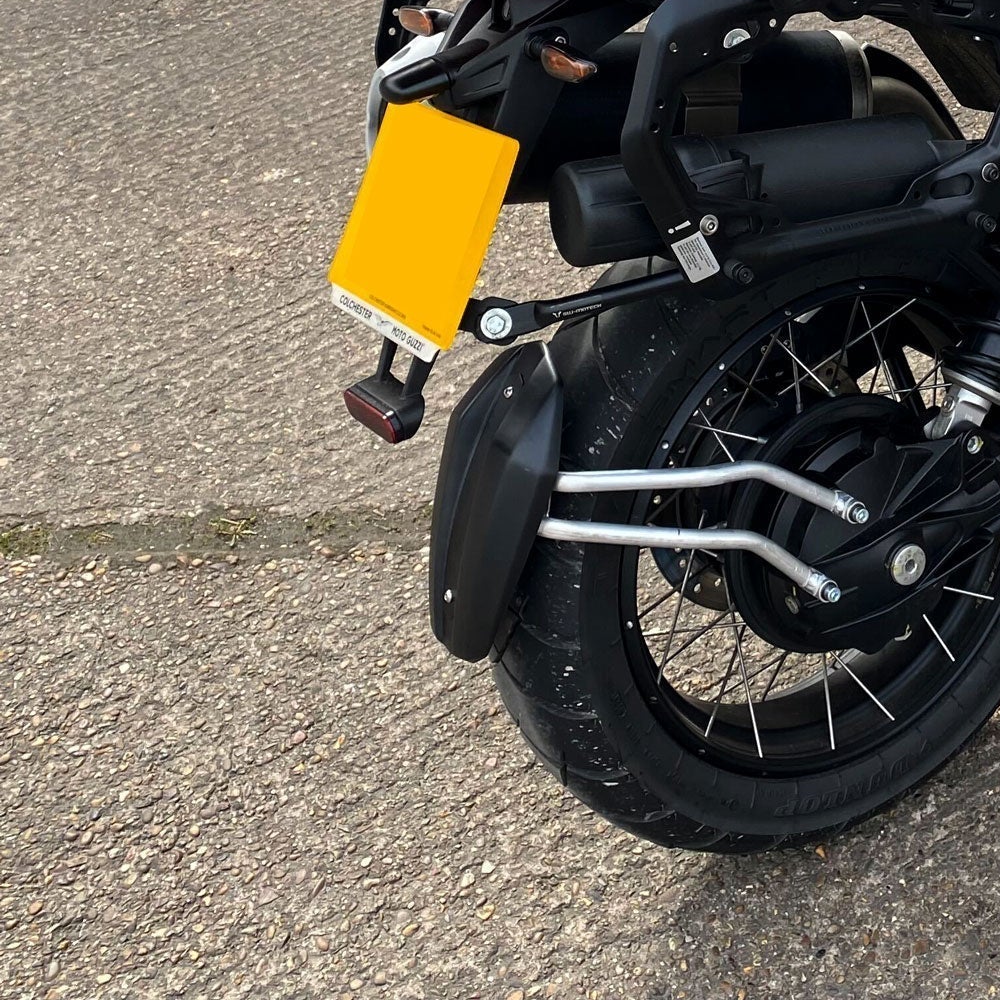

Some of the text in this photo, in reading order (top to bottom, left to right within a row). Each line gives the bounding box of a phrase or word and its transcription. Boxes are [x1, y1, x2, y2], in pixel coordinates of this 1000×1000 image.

[339, 294, 373, 320] COLCHESTER
[391, 325, 407, 341] MOTO
[406, 335, 426, 352] GUZZI
